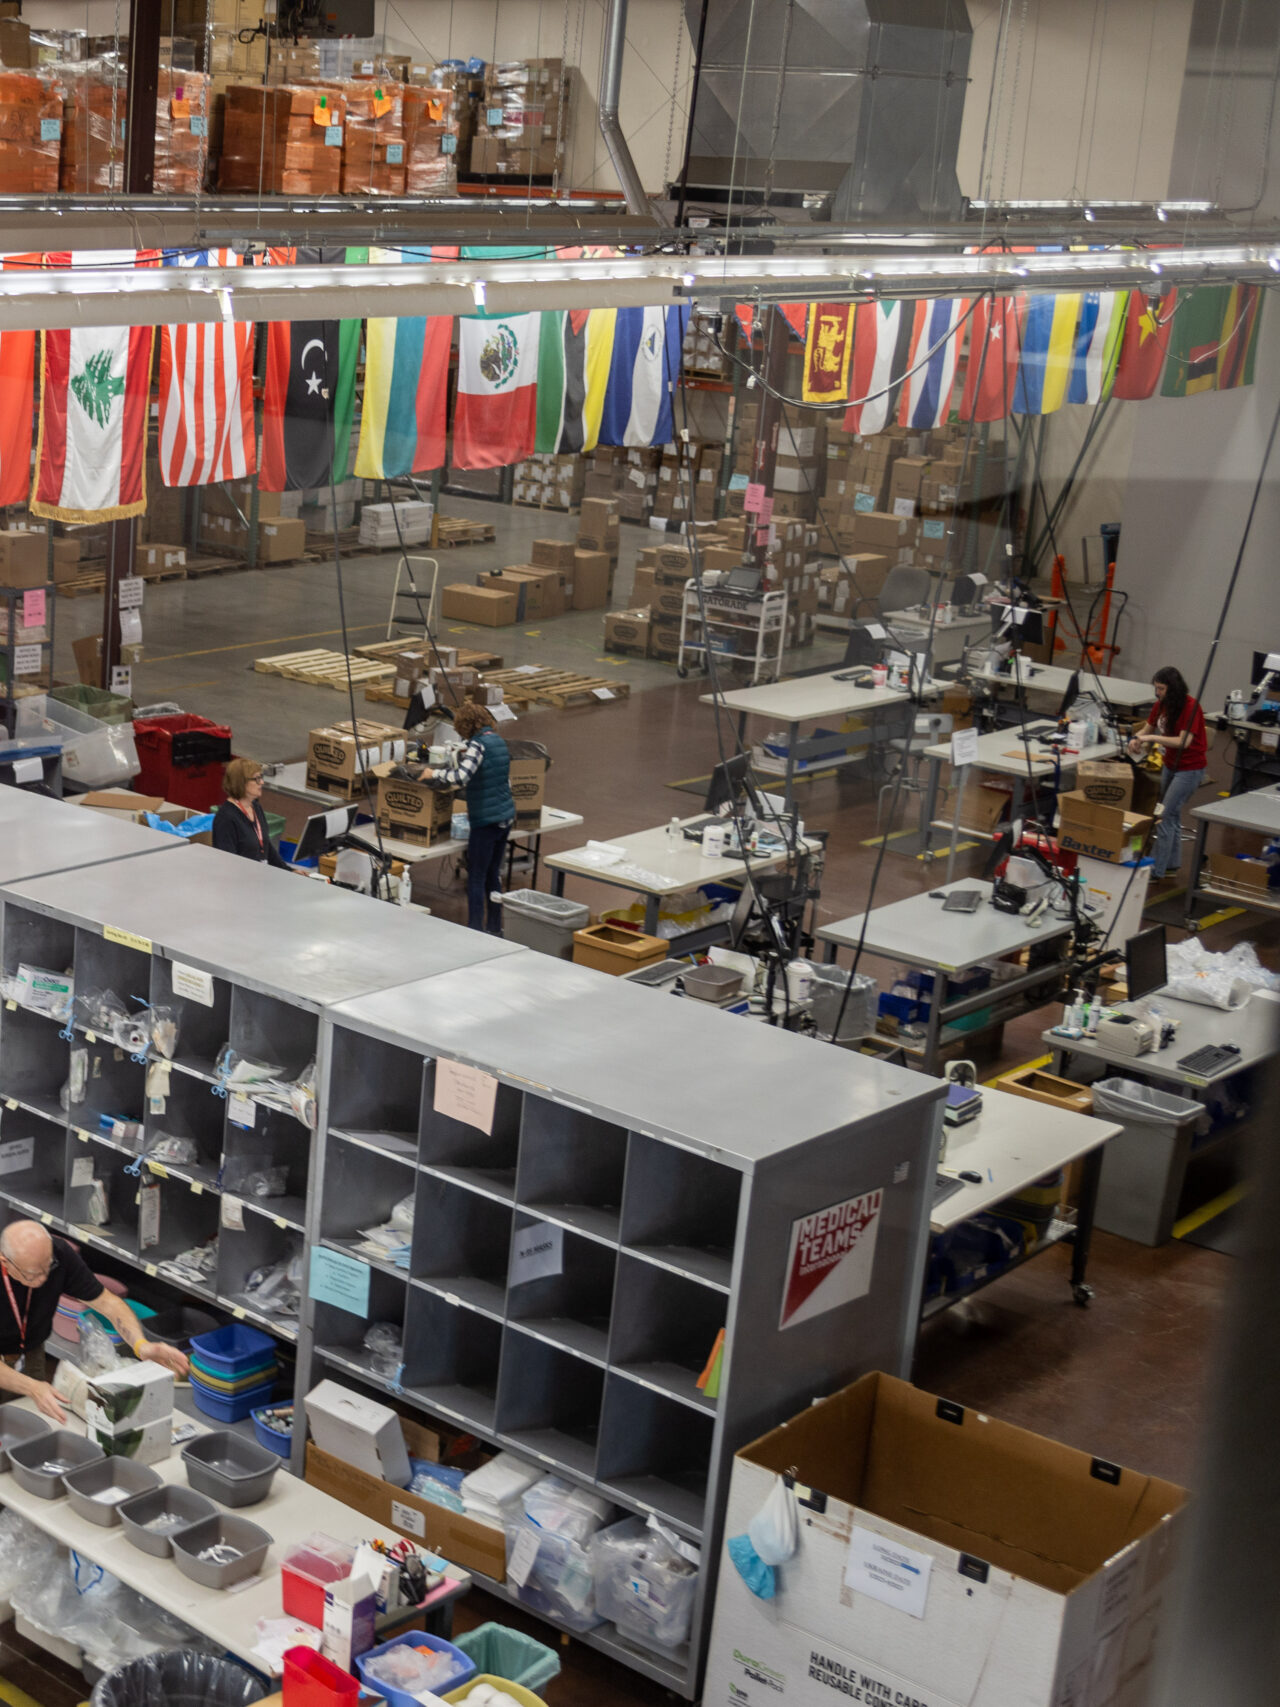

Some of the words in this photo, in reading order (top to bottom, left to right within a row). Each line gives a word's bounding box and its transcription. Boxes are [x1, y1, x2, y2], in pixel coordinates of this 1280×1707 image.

[386, 792, 422, 808] QUILTED
[1062, 836, 1116, 858] Baxter
[799, 1193, 880, 1242] MEDICAL
[808, 1664, 862, 1701] REUSABLE
[810, 1651, 856, 1683] HANDLE
[860, 1673, 892, 1700] WITH
